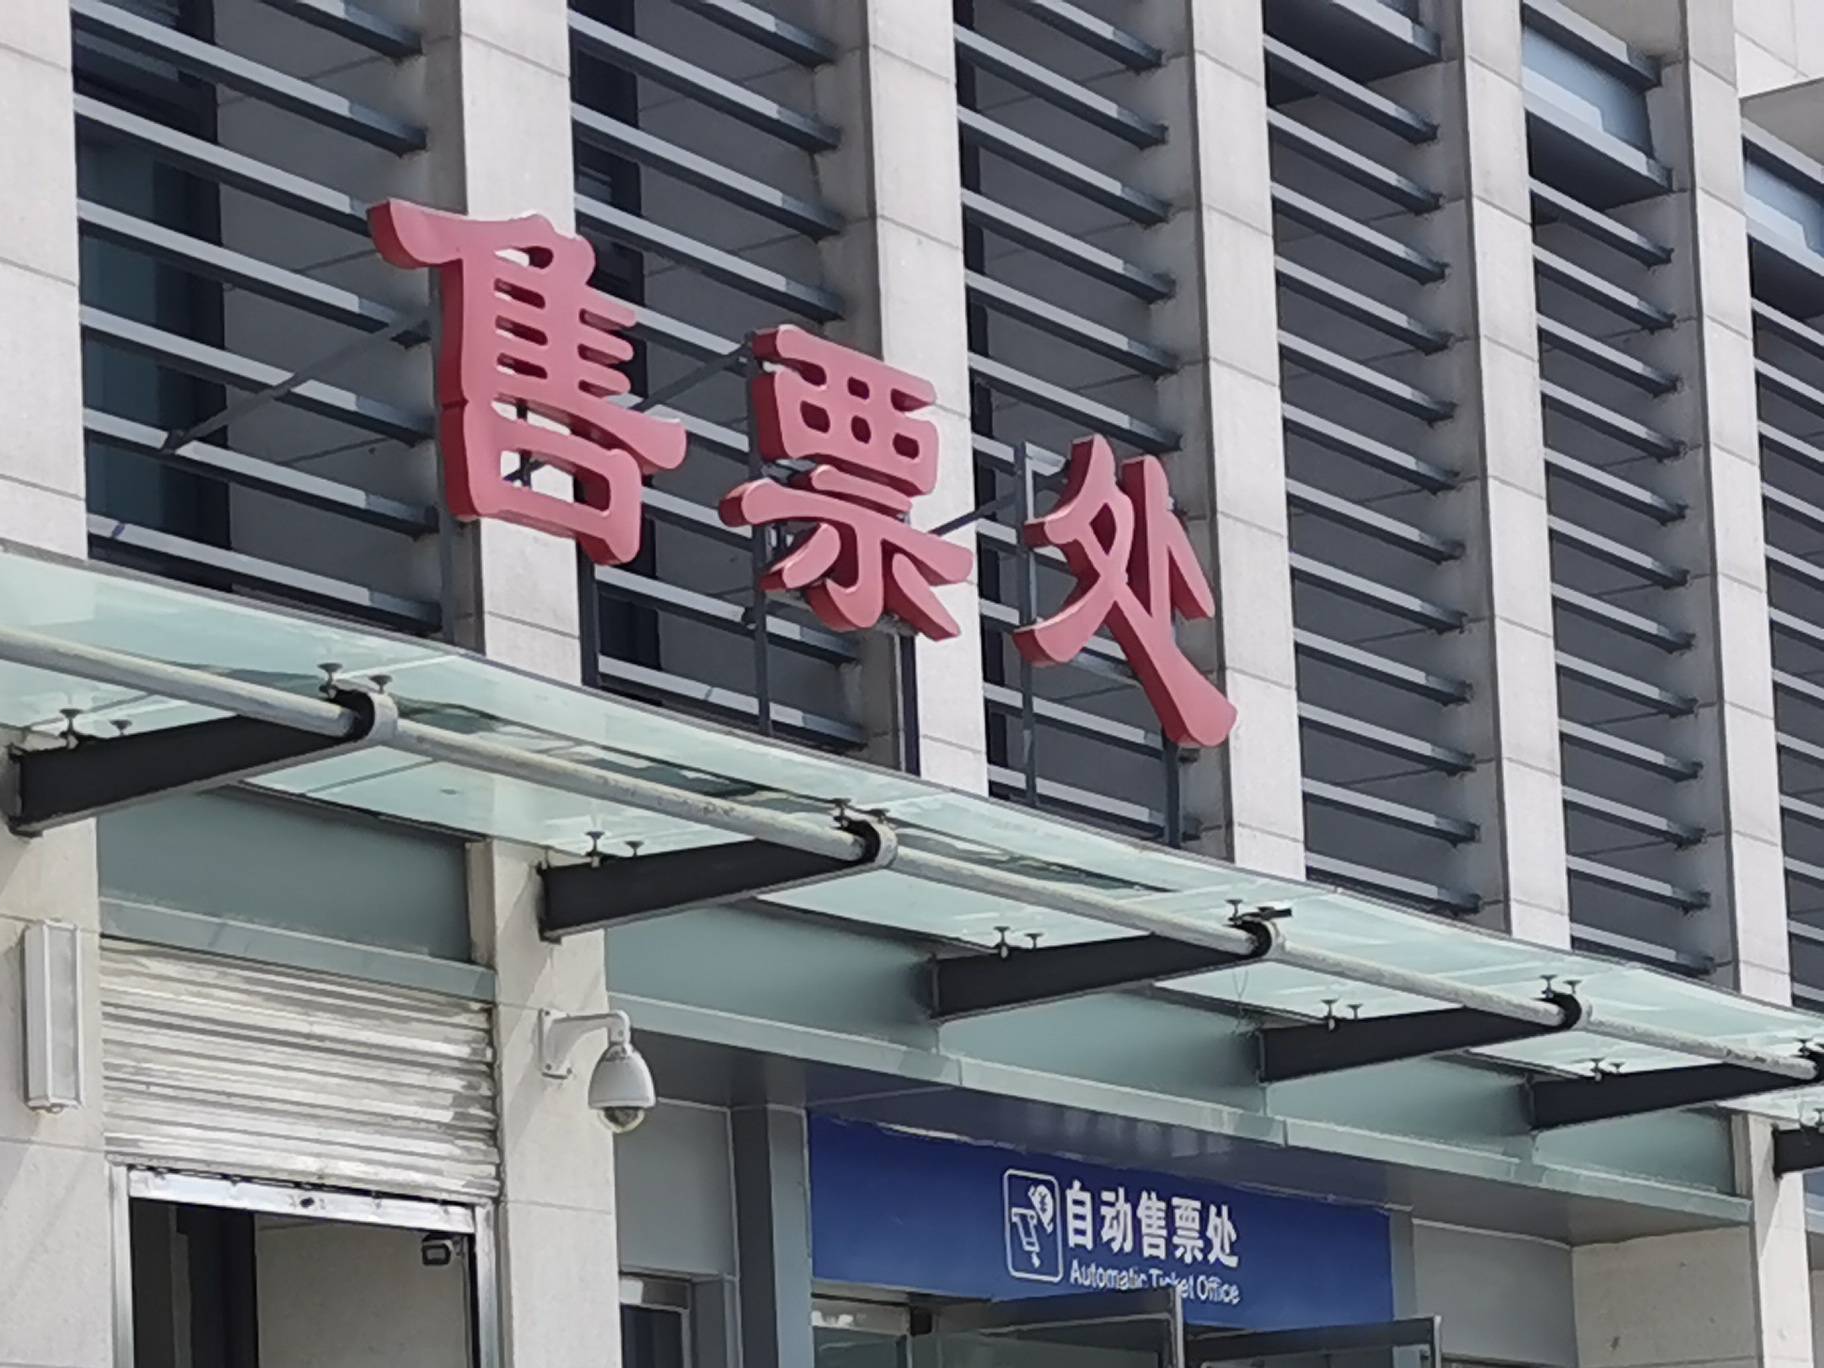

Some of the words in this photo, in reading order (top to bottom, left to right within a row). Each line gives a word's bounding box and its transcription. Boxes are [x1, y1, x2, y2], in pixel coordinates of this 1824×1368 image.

[367, 199, 1239, 748] 售票处
[1065, 1179, 1239, 1268] 自动售票处
[1196, 1275, 1241, 1305] Office
